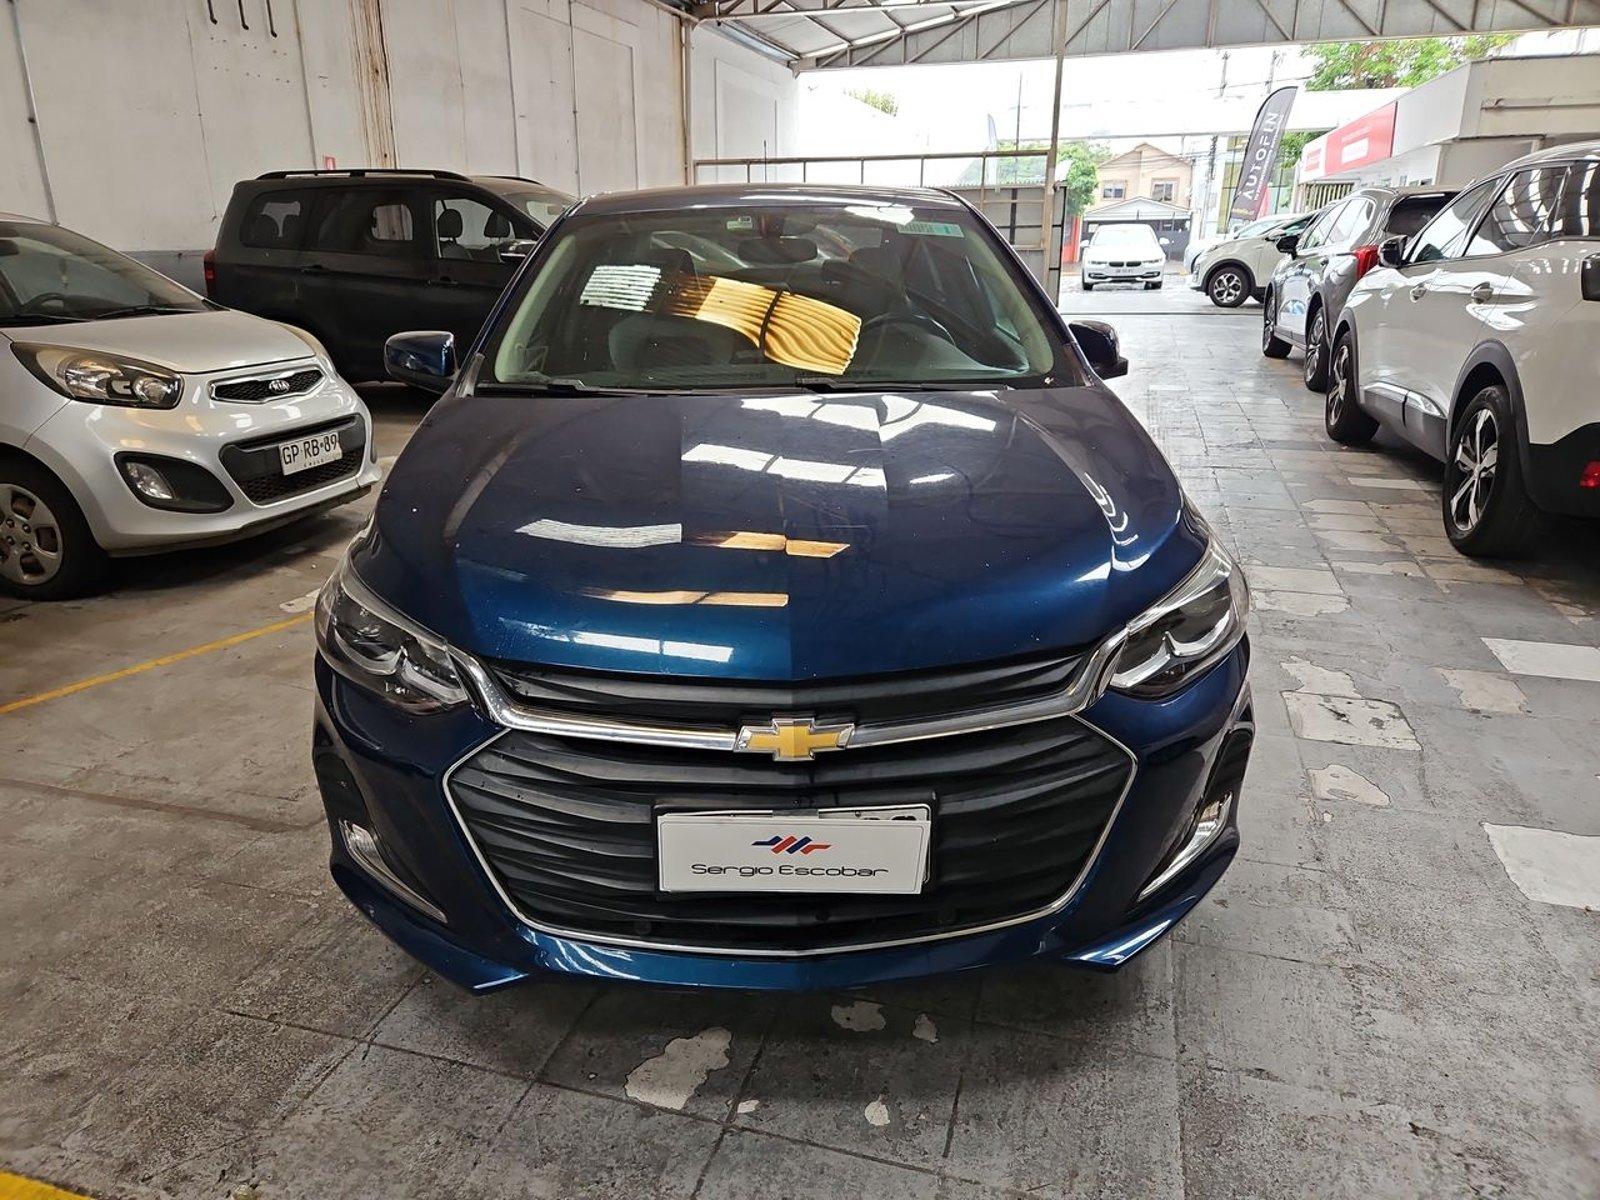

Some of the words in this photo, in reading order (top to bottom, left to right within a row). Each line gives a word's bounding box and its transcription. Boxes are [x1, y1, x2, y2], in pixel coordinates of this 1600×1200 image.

[1243, 112, 1279, 201] AUTOFIN
[269, 380, 290, 392] KIA
[690, 863, 774, 877] Sergio
[778, 864, 889, 877] Escobar
